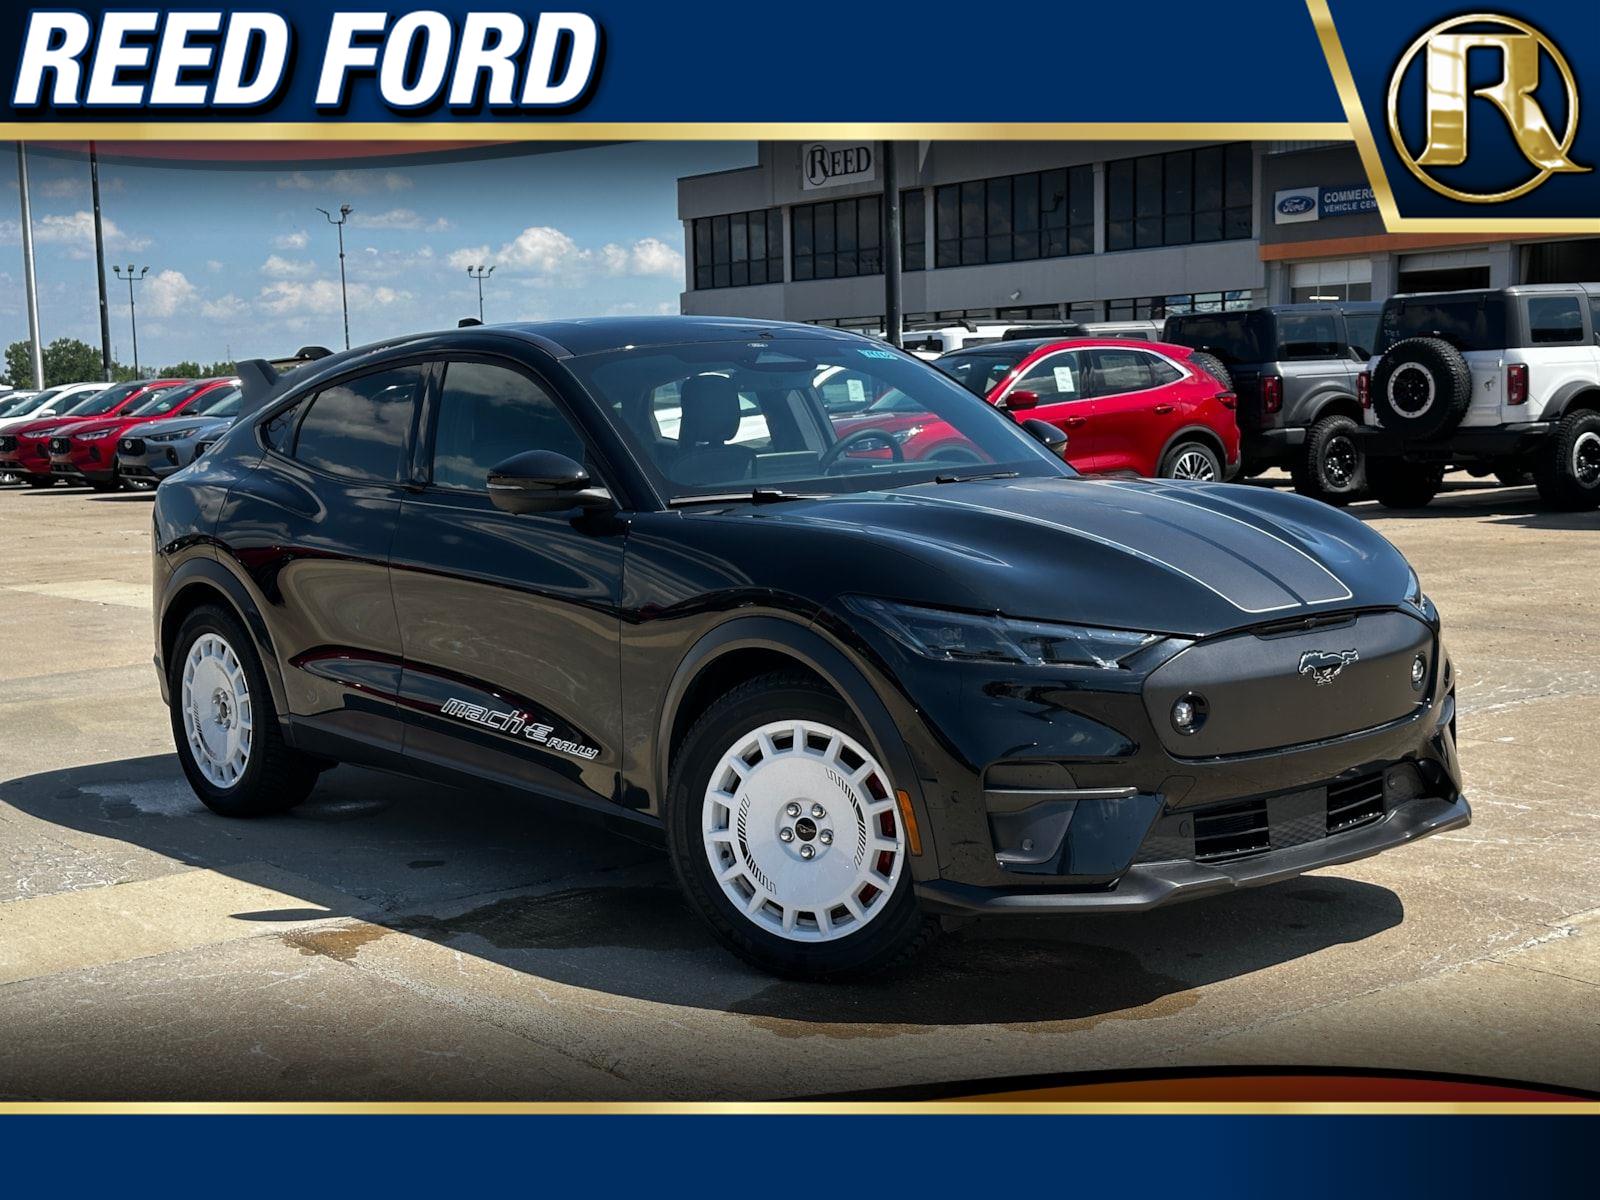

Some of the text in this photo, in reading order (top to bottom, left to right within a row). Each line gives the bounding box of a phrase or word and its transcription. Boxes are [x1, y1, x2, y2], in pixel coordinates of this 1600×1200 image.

[808, 146, 872, 179] REED
[1282, 199, 1307, 213] Ford
[1324, 201, 1358, 213] VEHICLE
[547, 737, 599, 760] RALLY
